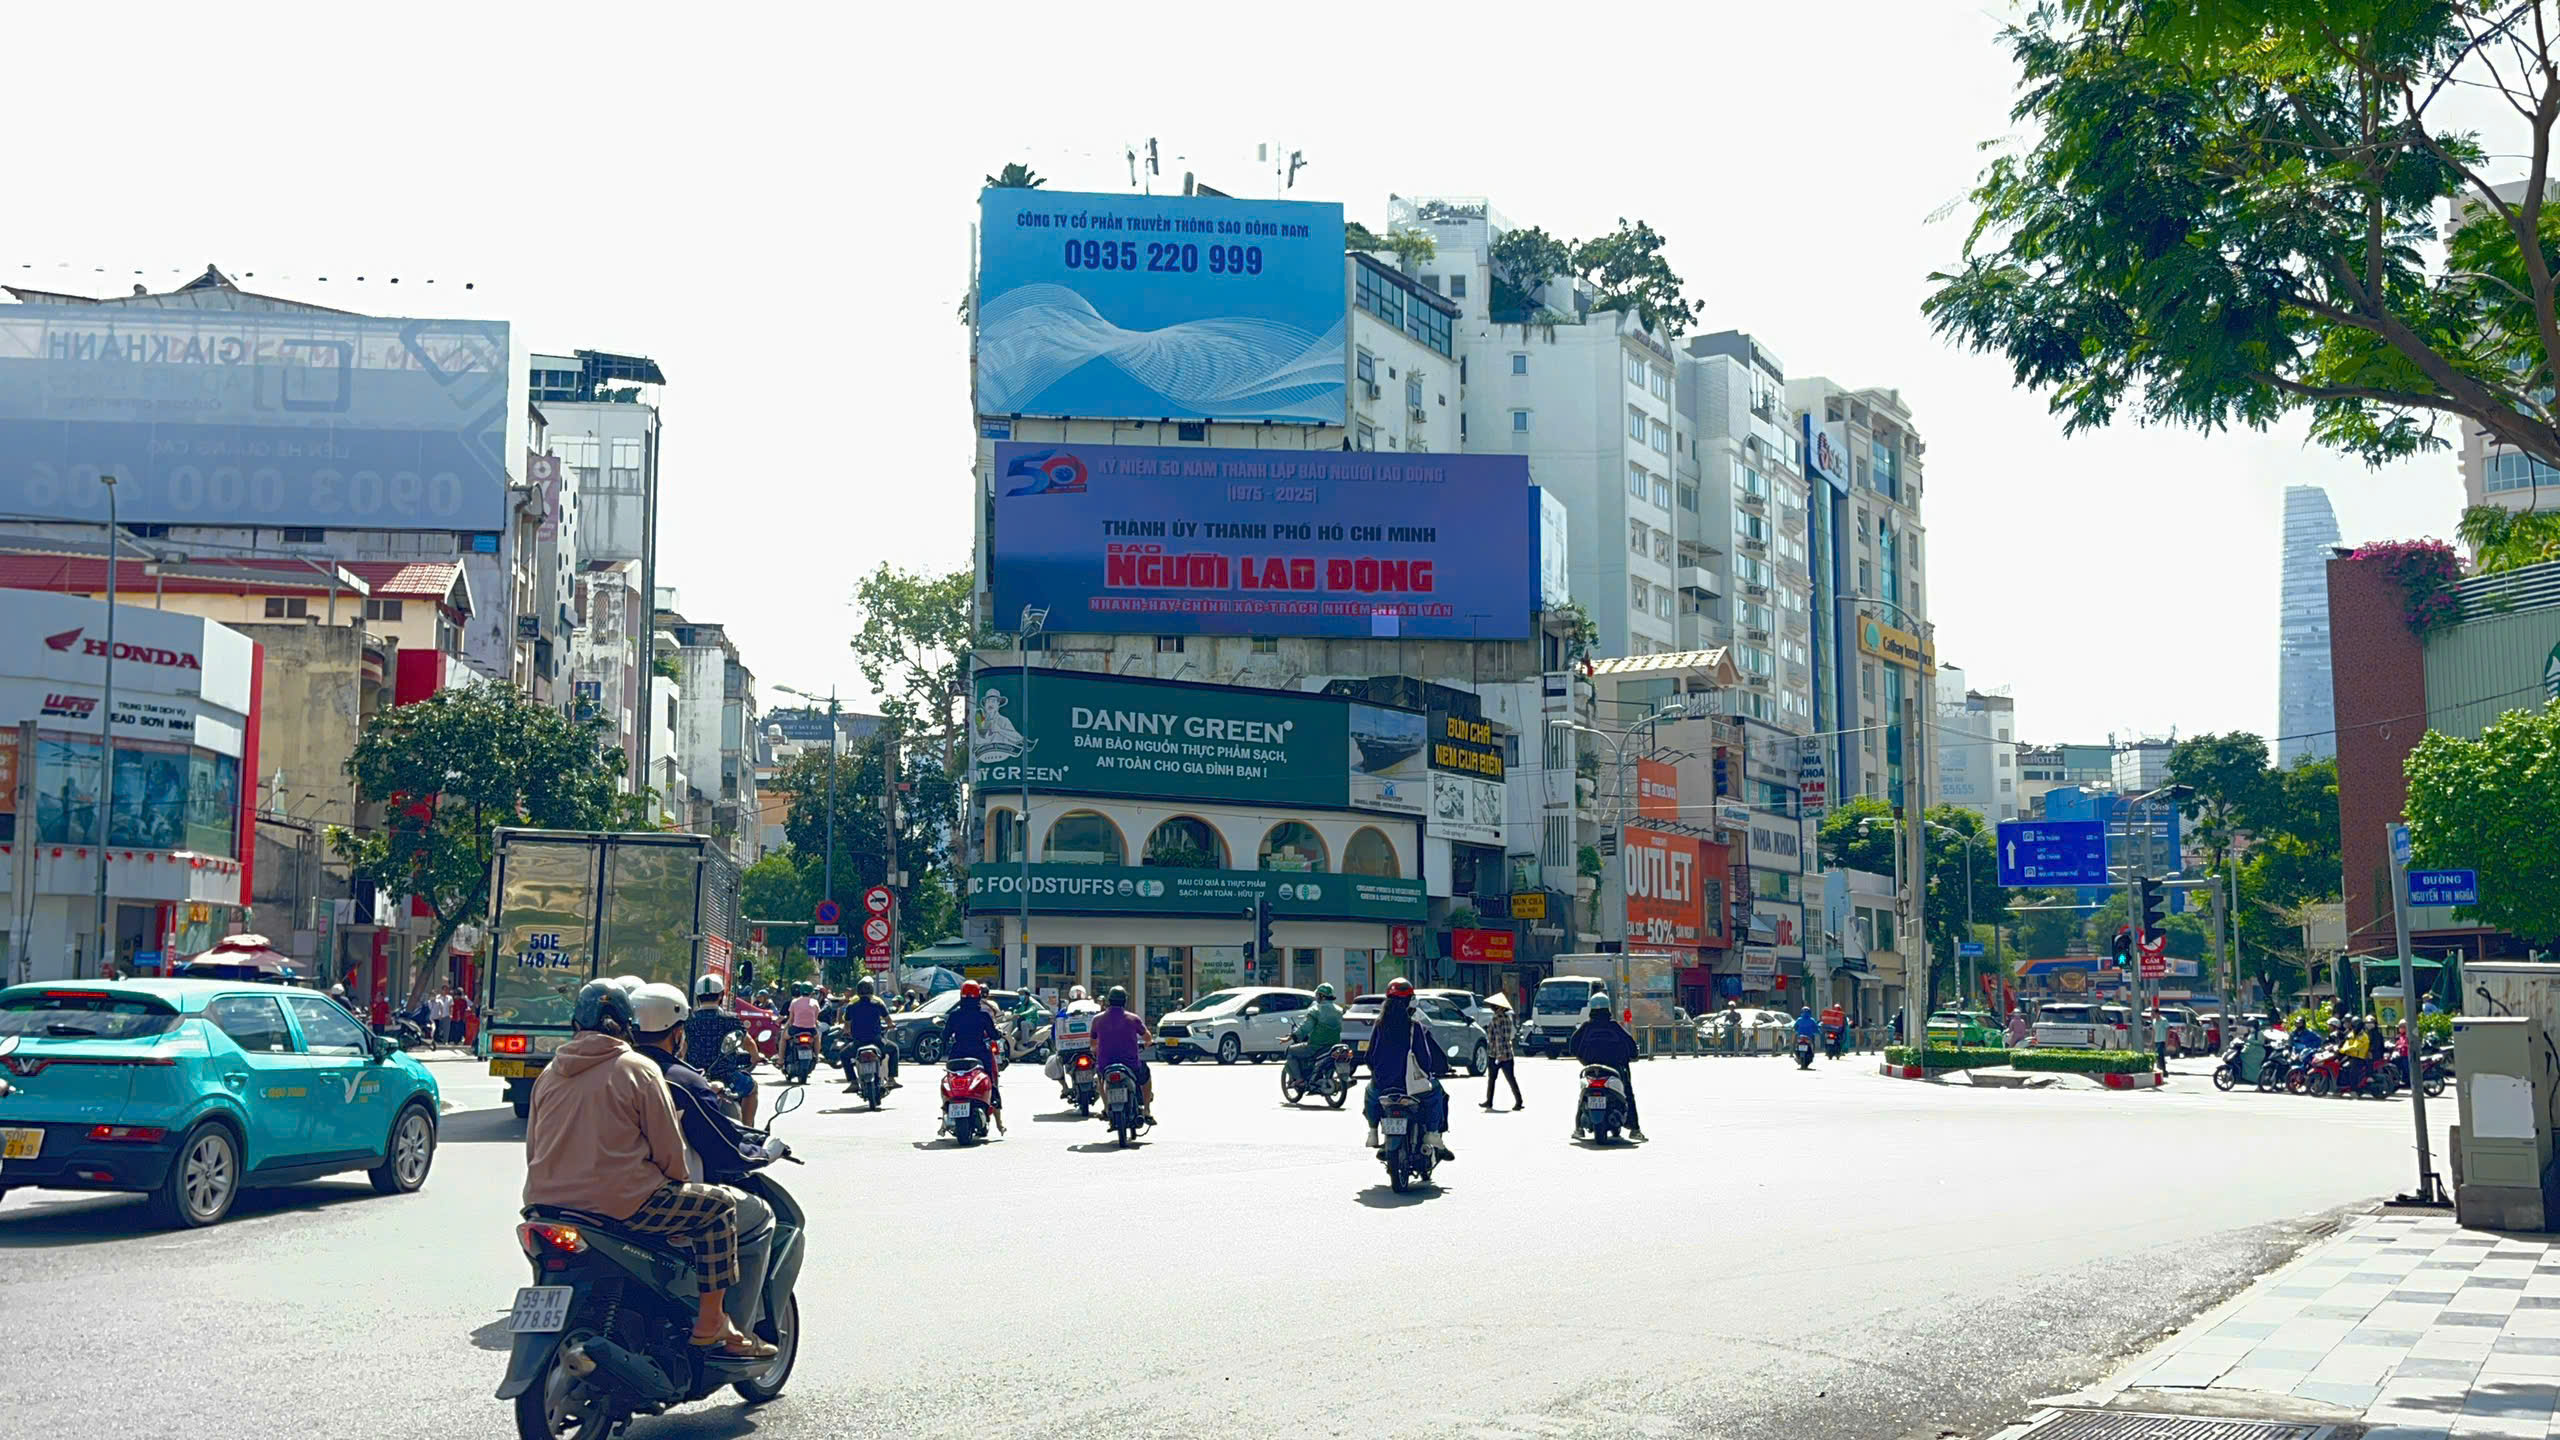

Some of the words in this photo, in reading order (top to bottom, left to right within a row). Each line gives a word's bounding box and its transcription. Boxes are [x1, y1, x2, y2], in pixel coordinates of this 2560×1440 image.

[1018, 211, 1050, 227] CÔNG
[1054, 215, 1067, 228] TY
[1071, 210, 1087, 228] CỔ
[1091, 212, 1122, 230] PHẦN
[1127, 214, 1171, 232] TRUYỀN
[1175, 217, 1214, 233] THÔNG
[1218, 221, 1241, 234] SAO
[1245, 220, 1278, 236] ĐÔNG
[1281, 224, 1309, 238] NAM
[1065, 239, 1138, 270] 0935
[1147, 243, 1198, 273] 220
[1209, 244, 1263, 275] 999
[1161, 461, 1180, 476] 50
[1377, 464, 1402, 481] LAO
[1102, 518, 1166, 537] THÀNH
[1172, 517, 1197, 537] ỦY
[1273, 521, 1312, 540] PHỐ
[1351, 523, 1382, 541] CHÍ
[1388, 527, 1436, 543] MINH
[1108, 553, 1229, 588] NGƯỜI
[1241, 556, 1316, 589] LAO
[1326, 556, 1433, 593] ĐỘNG
[83, 638, 201, 671] HONDA
[110, 712, 135, 724] EAD
[140, 716, 164, 729] SƠN
[168, 719, 194, 731] MINH
[1072, 707, 1178, 736] DANNY
[1184, 716, 1284, 744] GREEN
[1448, 717, 1468, 740] BÚN
[1470, 720, 1491, 745] CHẢ
[1074, 734, 1104, 750] ĐẢM
[1106, 734, 1132, 751] BẢO
[1135, 737, 1178, 755] NGUỒN
[1182, 743, 1215, 759] THỰC
[1217, 742, 1251, 759] PHẨM
[1253, 747, 1287, 764] SẠCH,
[1096, 756, 1115, 768] AN
[1117, 754, 1151, 770] TOÀN
[1154, 759, 1180, 773] CHO
[1183, 761, 1204, 774] GIA
[1206, 758, 1234, 776] ĐÌNH
[1236, 764, 1260, 779] BẠN
[1435, 744, 1457, 768] NEM
[1458, 749, 1478, 771] CUA
[1479, 748, 1502, 776] BIỂN
[1803, 756, 1821, 765] NHA
[992, 766, 1063, 781] GREEN
[1800, 768, 1824, 777] KHOA
[1801, 781, 1824, 792] TÂM
[1753, 828, 1772, 853] NHA
[1774, 832, 1796, 857] KHOA
[1194, 877, 1203, 886] CỦ
[1204, 878, 1219, 887] QUẢ
[1625, 844, 1692, 902] OUTLET
[2423, 873, 2462, 885] ĐƯỜNG
[988, 876, 1115, 895] FOODSTUFFS
[1214, 889, 1233, 897] TOÀN
[2411, 888, 2438, 902] NGUYỄN
[1648, 917, 1674, 944] 50%
[530, 933, 561, 950] 50E
[517, 952, 570, 968] 148.74
[522, 1291, 562, 1308] 59-N1
[511, 1311, 562, 1329] 778.85
